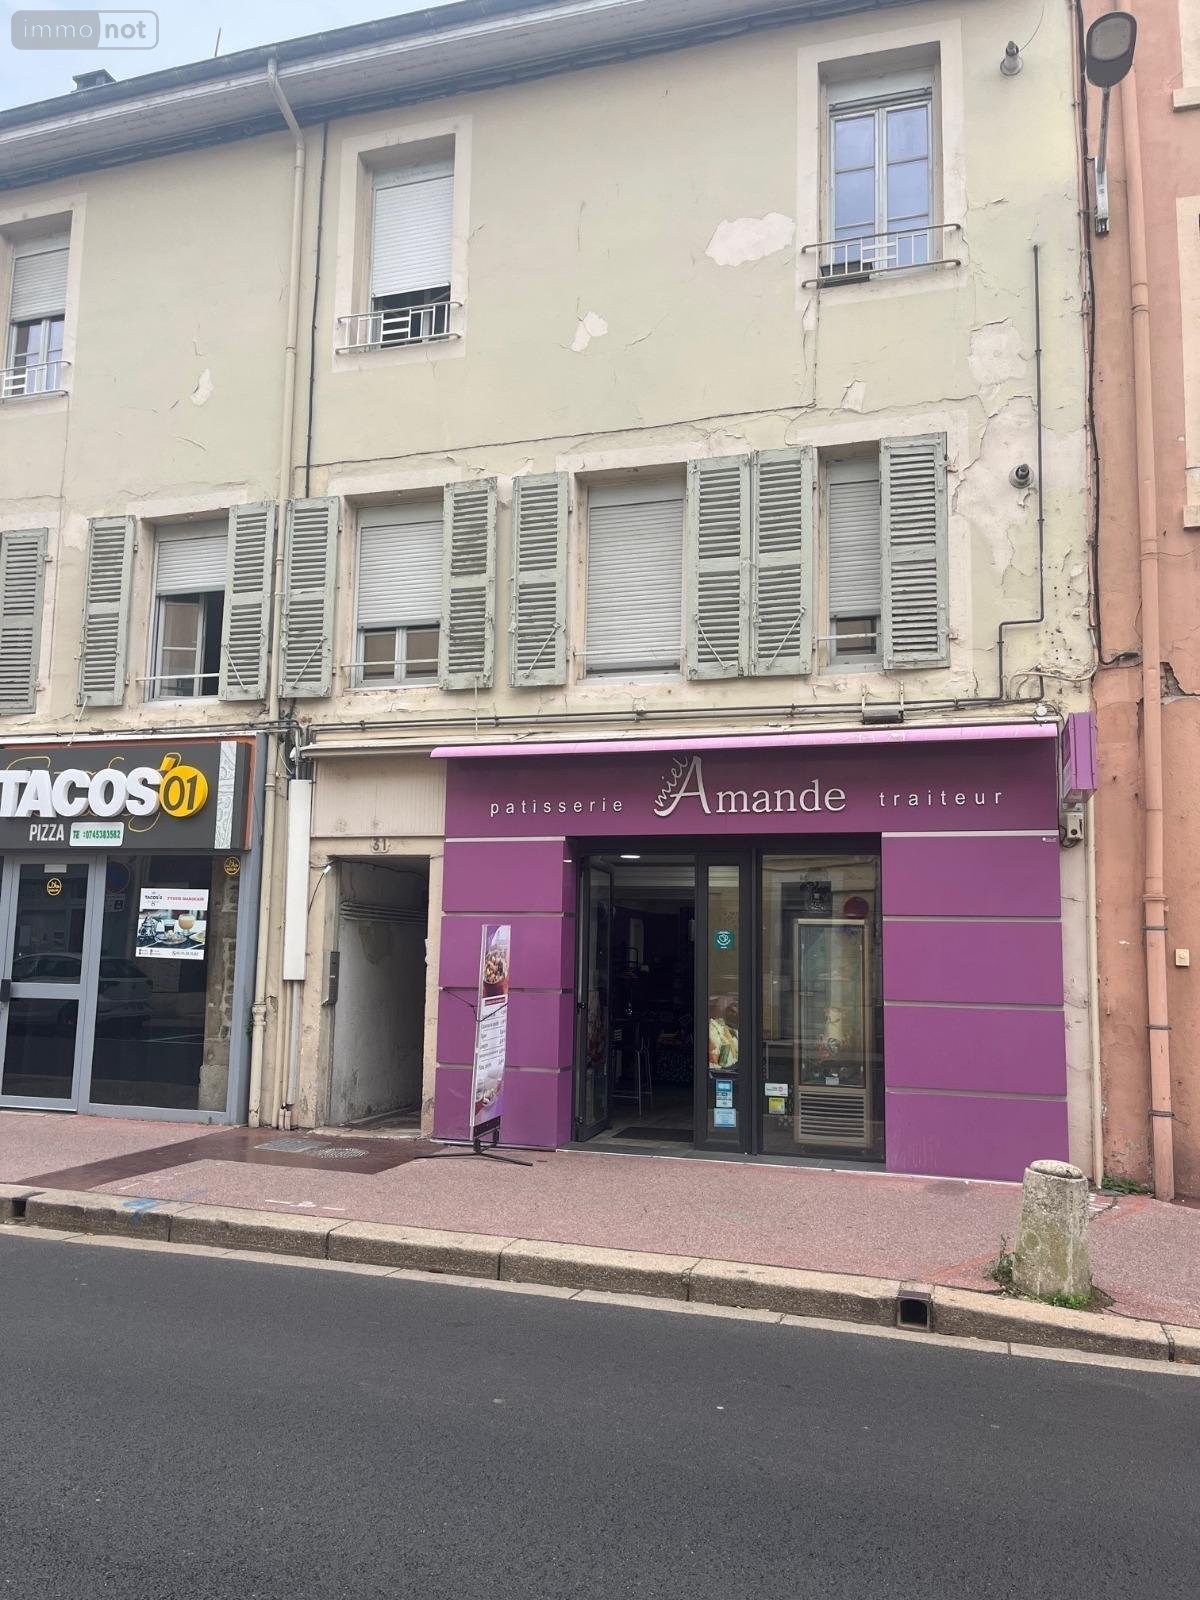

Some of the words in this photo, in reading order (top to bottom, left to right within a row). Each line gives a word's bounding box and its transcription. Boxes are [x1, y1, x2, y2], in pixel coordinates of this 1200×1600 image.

[490, 798, 623, 817] patisserie
[654, 755, 847, 817] Amande
[879, 789, 1002, 807] traiteur
[29, 824, 65, 842] PIZZA
[372, 837, 386, 851] 31
